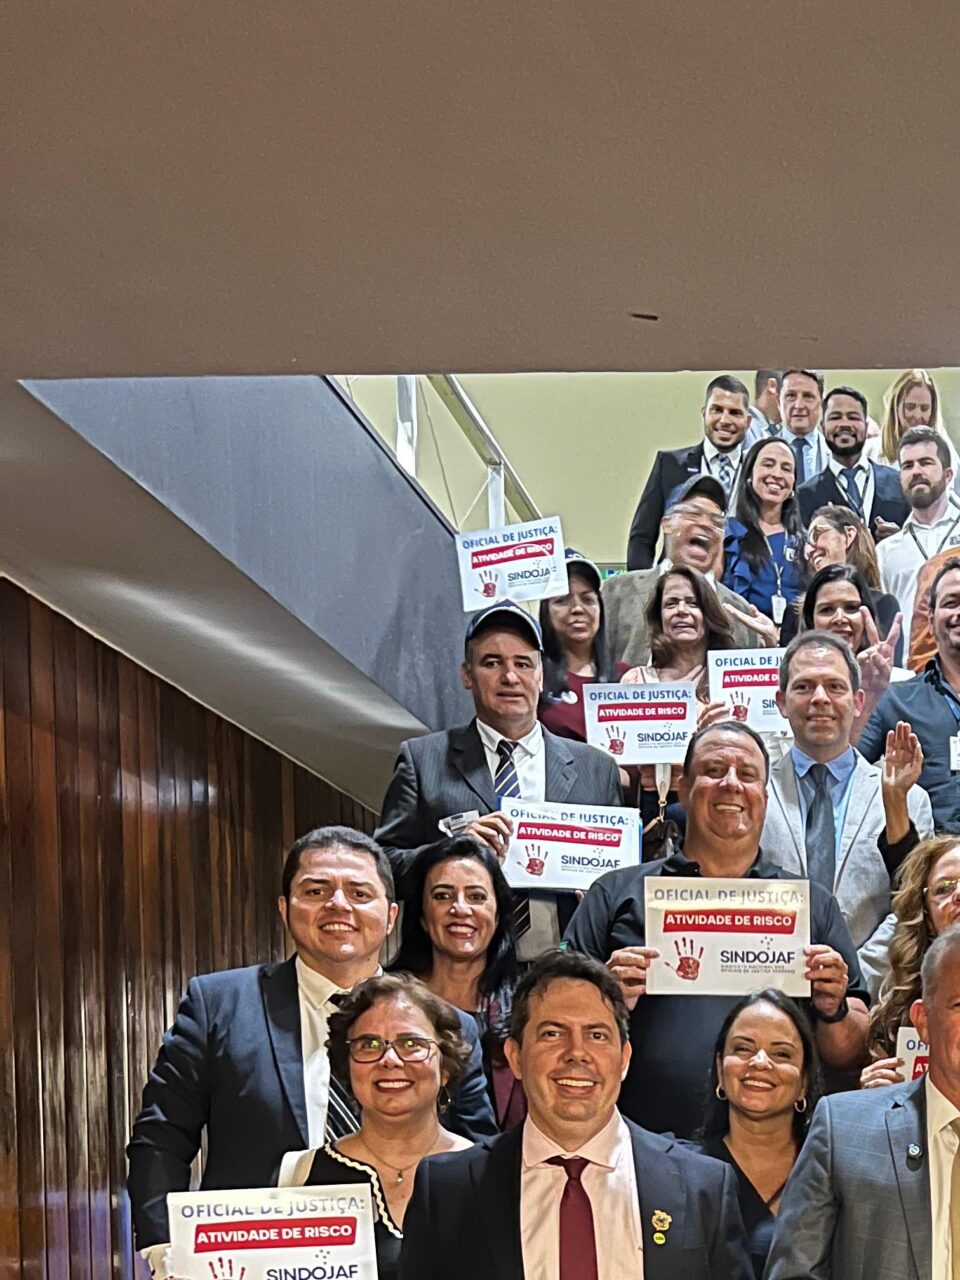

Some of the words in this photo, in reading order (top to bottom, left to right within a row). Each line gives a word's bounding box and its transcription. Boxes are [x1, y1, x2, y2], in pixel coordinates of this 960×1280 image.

[462, 535, 500, 549] OFICIAL
[503, 531, 515, 543] DE
[518, 525, 558, 542] JUSTIÇA:
[715, 656, 756, 667] OFICIAL
[759, 656, 773, 665] DE
[723, 673, 770, 683] ATIVIDADE
[771, 673, 779, 682] D
[589, 692, 630, 701] OFICIAL
[632, 690, 646, 700] DE
[647, 689, 692, 701] JUSTIÇA:
[599, 708, 645, 717] ATIVIDADE
[645, 707, 657, 716] DE
[658, 706, 685, 715] RISCO
[637, 731, 689, 742] SINDOJAF
[519, 826, 572, 837] ATIVIDADE
[572, 831, 587, 839] DE
[587, 831, 619, 842] RISCO
[561, 855, 621, 869] SINDOJAF
[654, 889, 709, 901] OFICIAL
[718, 890, 736, 901] DE
[741, 890, 804, 905] JUSTIÇA:
[665, 914, 734, 925] ATIVIDADE
[735, 915, 752, 926] DE
[753, 915, 792, 926] RISCO
[720, 950, 796, 964] SINDOJAF
[181, 1203, 254, 1218] OFICIAL
[287, 1196, 365, 1216] JUSTIÇA:
[196, 1227, 280, 1243] ATIVIDADE
[281, 1227, 302, 1240] DE
[307, 1224, 353, 1239] RISCO
